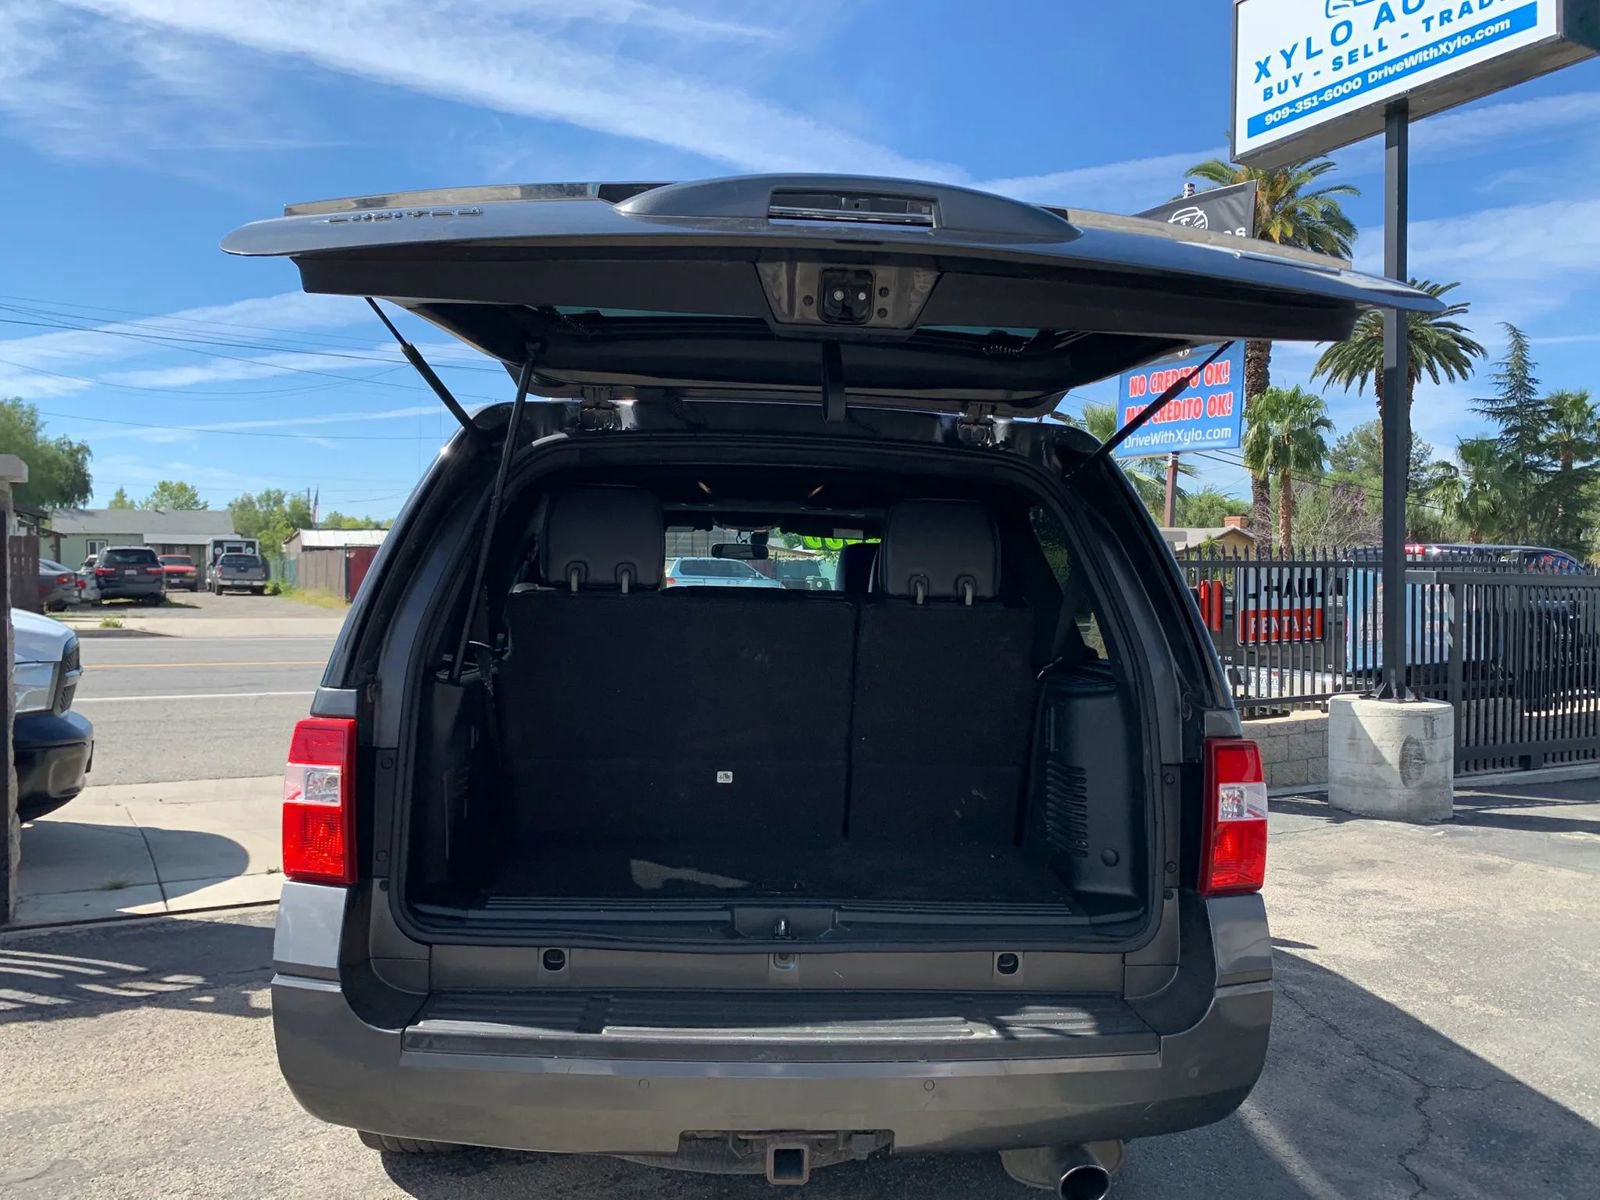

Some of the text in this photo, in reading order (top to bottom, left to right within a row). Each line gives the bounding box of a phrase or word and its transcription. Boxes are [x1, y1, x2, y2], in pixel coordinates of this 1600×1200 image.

[1254, 20, 1353, 84] XYLO
[1263, 72, 1303, 102] BUY
[1332, 37, 1389, 72] SELL
[1422, 0, 1504, 32] TRAD
[1264, 18, 1511, 126] 909-351-6000 DriveWithXylo.com
[1129, 374, 1147, 398] NO
[1204, 360, 1231, 387] OK!
[1207, 392, 1234, 417] OK!
[1124, 427, 1232, 449] DriveWithXylo.com
[1243, 577, 1325, 599] -HAUL
[1250, 615, 1315, 634] RENTAS
